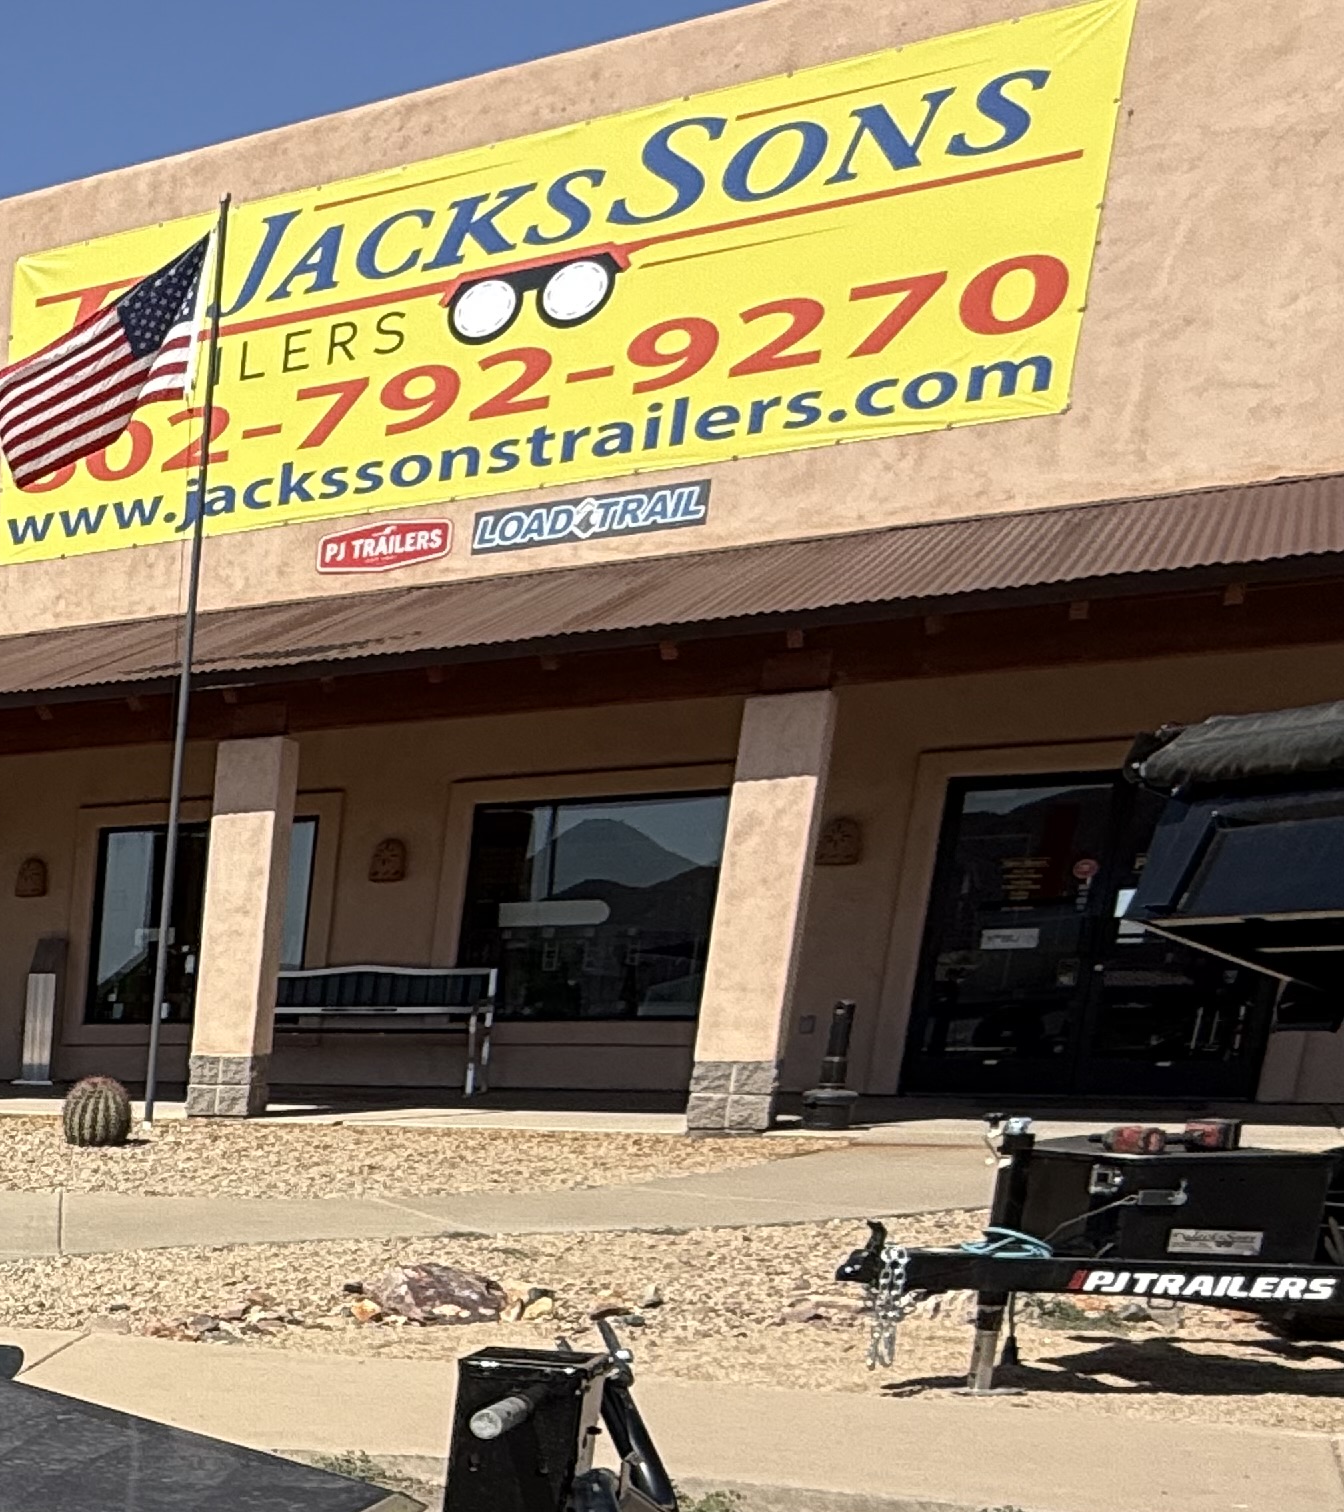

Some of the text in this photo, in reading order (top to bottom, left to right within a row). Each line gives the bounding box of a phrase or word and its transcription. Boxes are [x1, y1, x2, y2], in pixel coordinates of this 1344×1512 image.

[6, 354, 1053, 546] www.jackssonstrailers.com
[324, 542, 347, 563] PJ
[350, 526, 443, 559] TRAILERS
[474, 486, 707, 549] LOAD TRAIL
